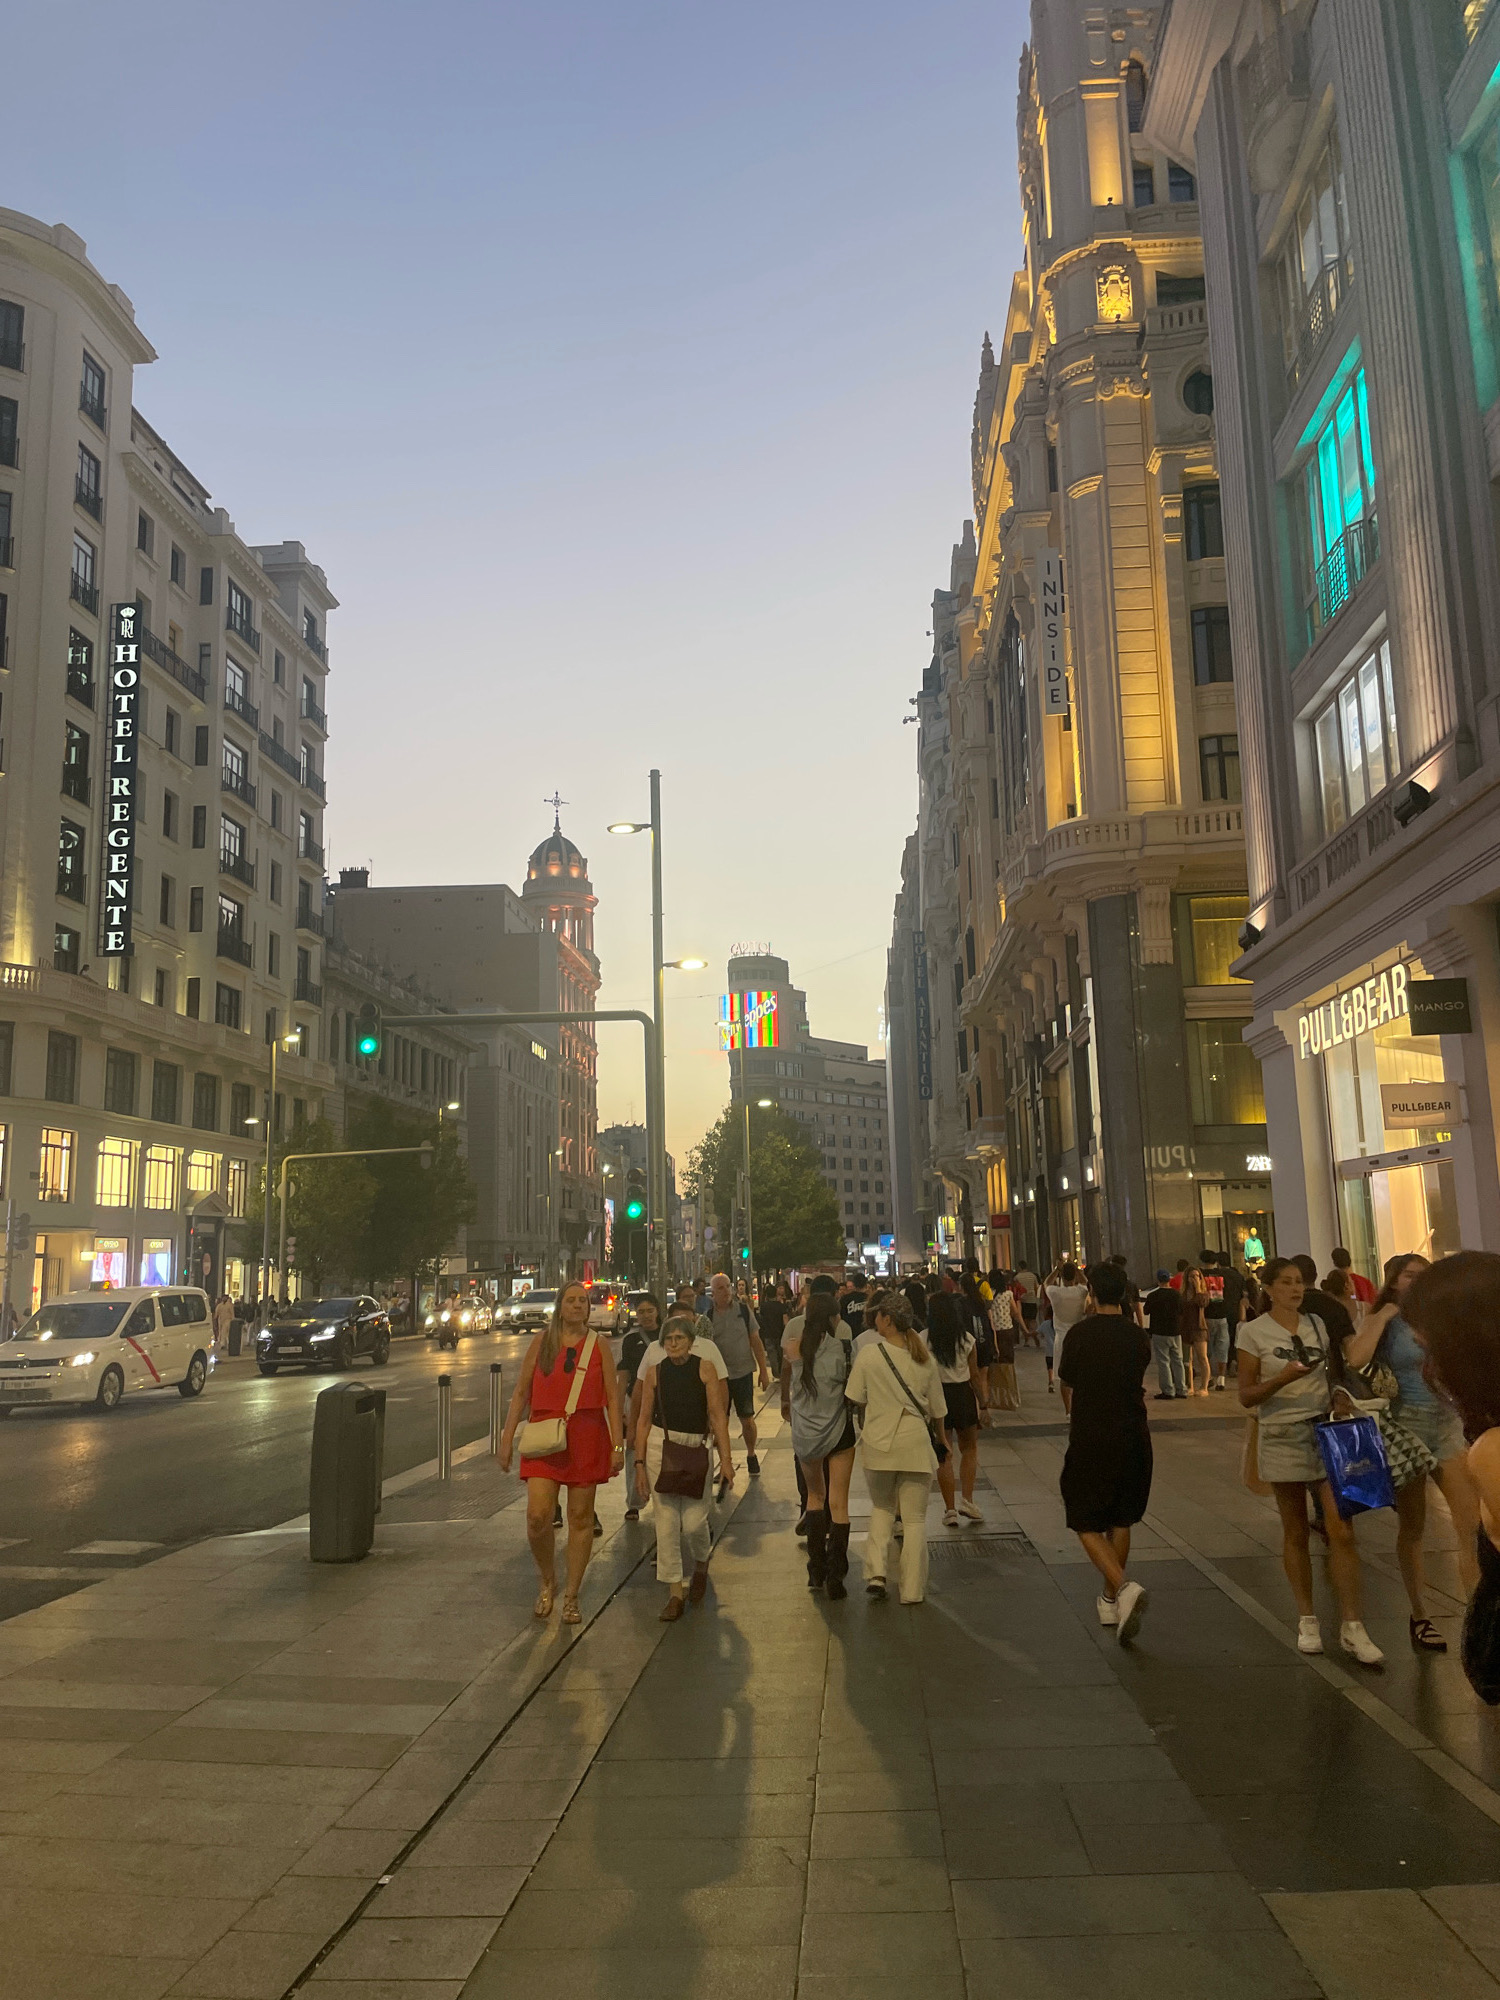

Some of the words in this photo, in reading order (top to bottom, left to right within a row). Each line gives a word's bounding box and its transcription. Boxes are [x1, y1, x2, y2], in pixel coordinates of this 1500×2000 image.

[1042, 560, 1061, 704] INNSiDE
[113, 643, 139, 764] HOTEL
[105, 777, 131, 951] REGENTE
[914, 932, 925, 989] HOTEL
[1413, 1001, 1465, 1013] MANGO
[918, 995, 930, 1098] ATLANTICO
[1298, 963, 1409, 1060] PULL&BEAR
[1391, 1100, 1452, 1113] PULL&BEAR
